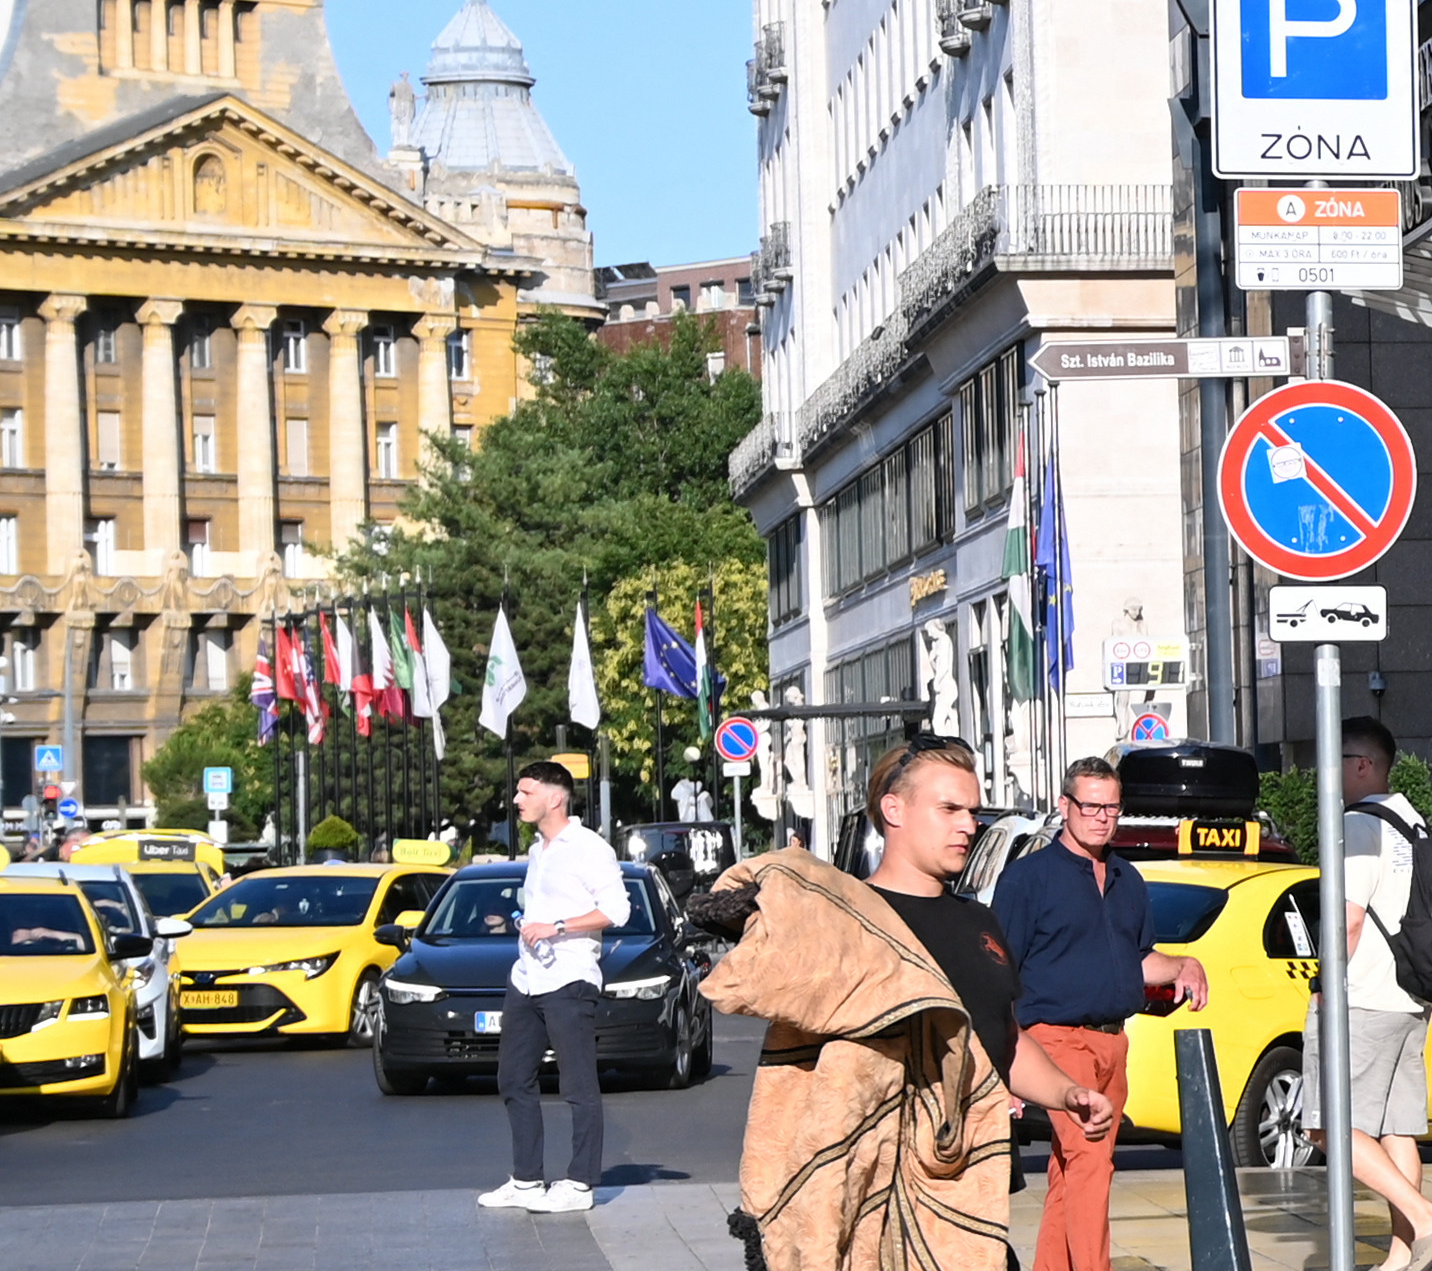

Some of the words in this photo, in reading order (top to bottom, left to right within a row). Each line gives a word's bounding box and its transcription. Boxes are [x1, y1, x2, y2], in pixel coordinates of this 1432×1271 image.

[1260, 125, 1371, 161] ZÓNA
[1285, 201, 1297, 216] A
[1314, 197, 1366, 218] ZÓNA
[1298, 267, 1335, 283] 0501
[1060, 353, 1084, 369] Szt.
[1087, 352, 1125, 368] István
[1127, 351, 1175, 368] Bazilika
[1196, 827, 1241, 848] TAXI
[143, 844, 170, 856] Uber
[171, 844, 189, 856] Taxi
